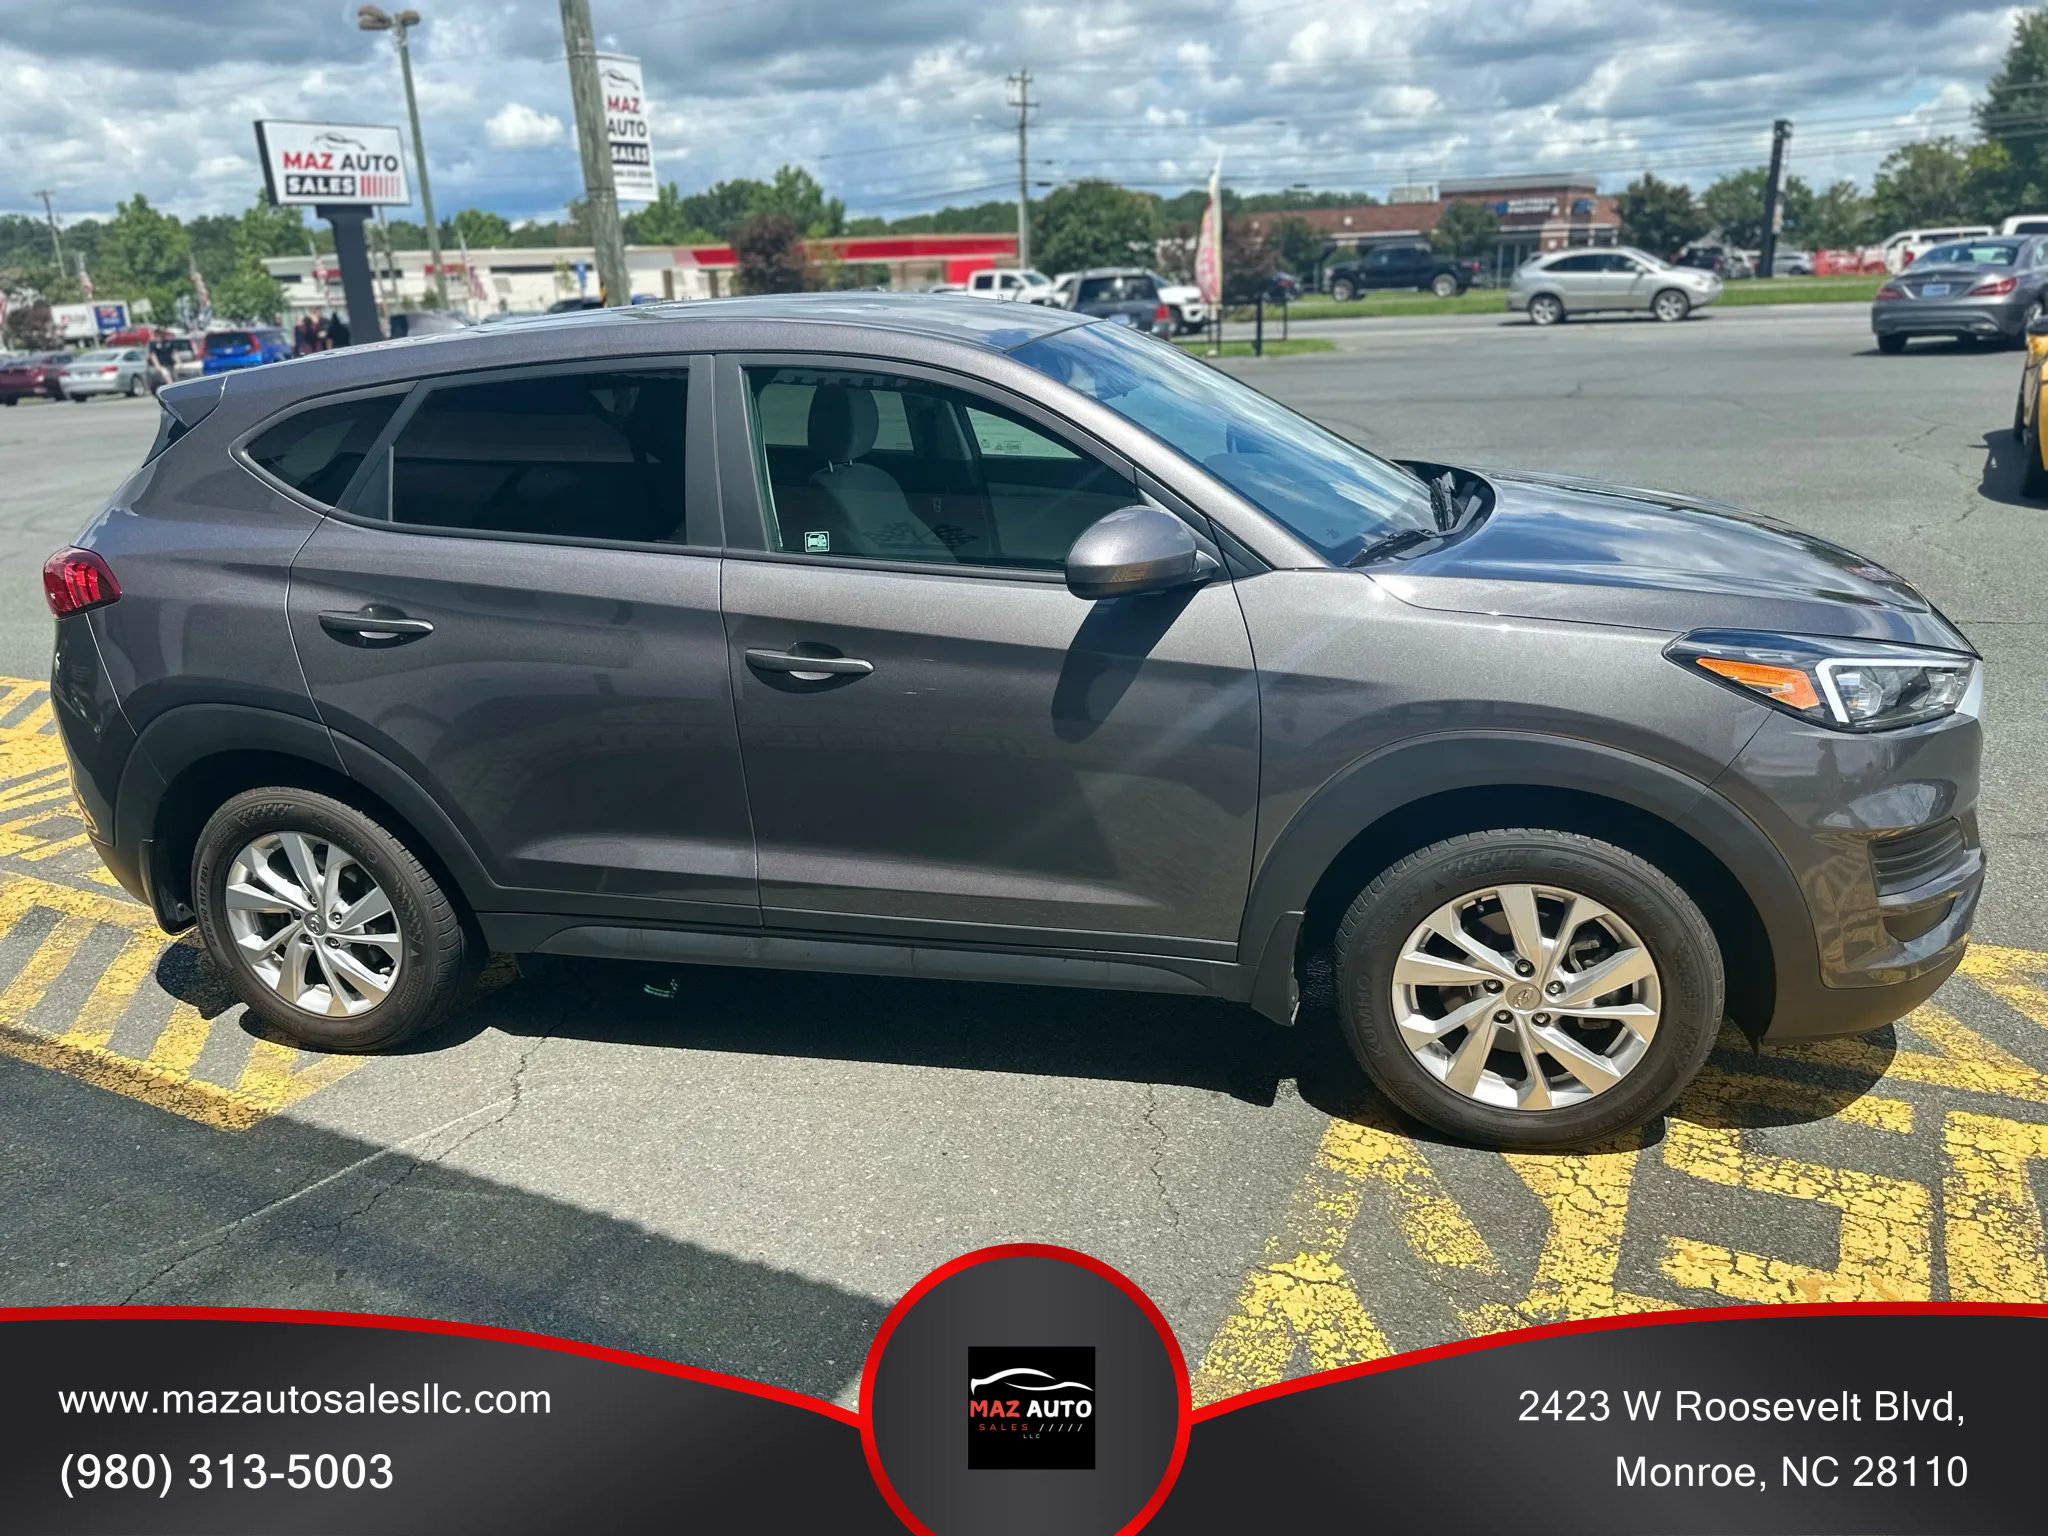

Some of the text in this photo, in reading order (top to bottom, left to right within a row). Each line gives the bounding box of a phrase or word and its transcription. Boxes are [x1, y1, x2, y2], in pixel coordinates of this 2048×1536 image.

[607, 95, 641, 114] MAZ
[607, 118, 647, 137] AUTO
[282, 151, 398, 172] MAZ AUTO
[610, 145, 649, 162] SALES
[288, 177, 354, 194] SALES
